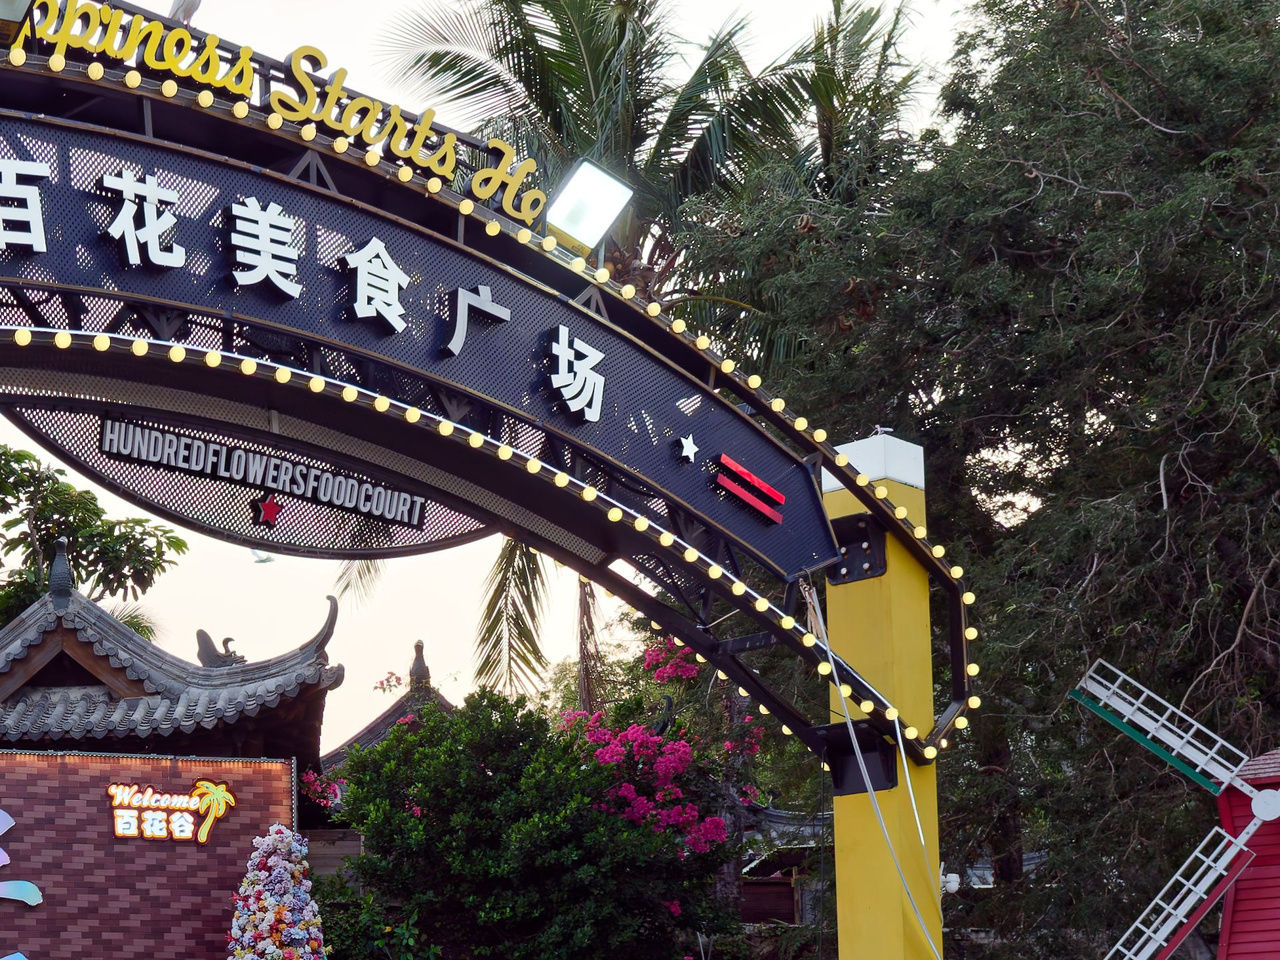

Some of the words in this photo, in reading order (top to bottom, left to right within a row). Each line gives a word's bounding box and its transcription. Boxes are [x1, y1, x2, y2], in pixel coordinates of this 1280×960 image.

[270, 46, 457, 180] Starts
[472, 138, 547, 226] He
[108, 784, 201, 811] Welcome
[114, 809, 195, 839] 百花谷
